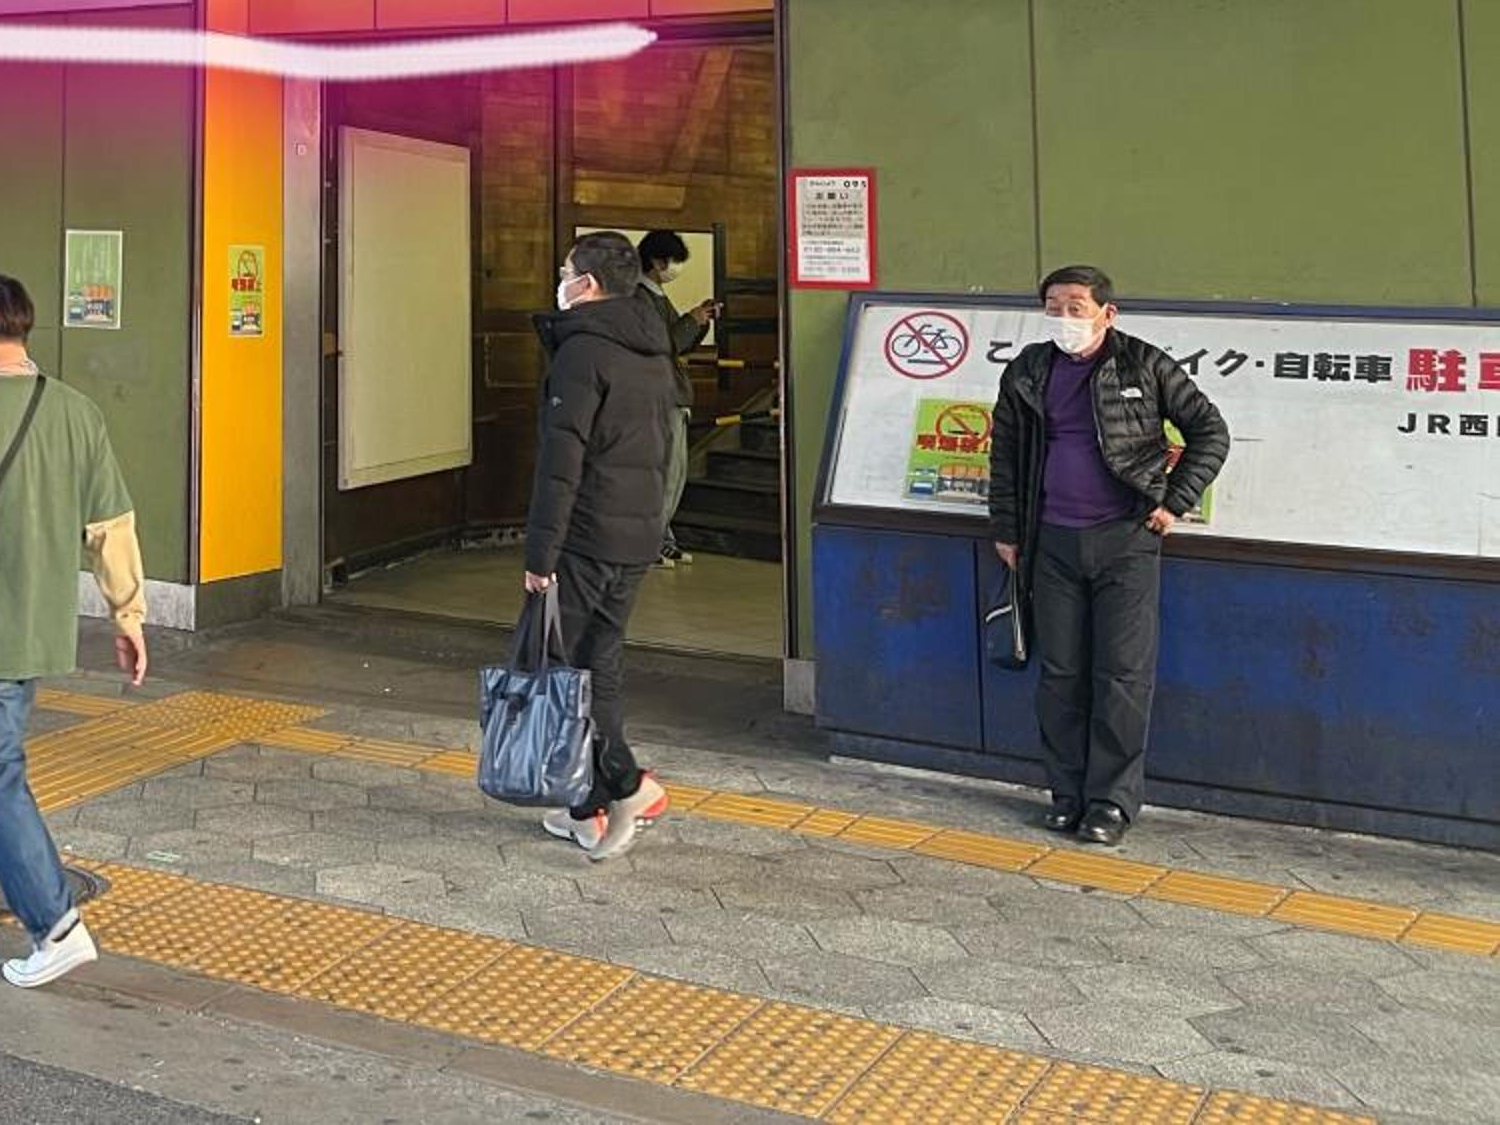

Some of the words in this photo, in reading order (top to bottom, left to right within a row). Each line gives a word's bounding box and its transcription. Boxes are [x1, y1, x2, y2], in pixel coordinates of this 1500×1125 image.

[1164, 345, 1393, 385] イク・自転車
[1397, 412, 1500, 438] JR西
